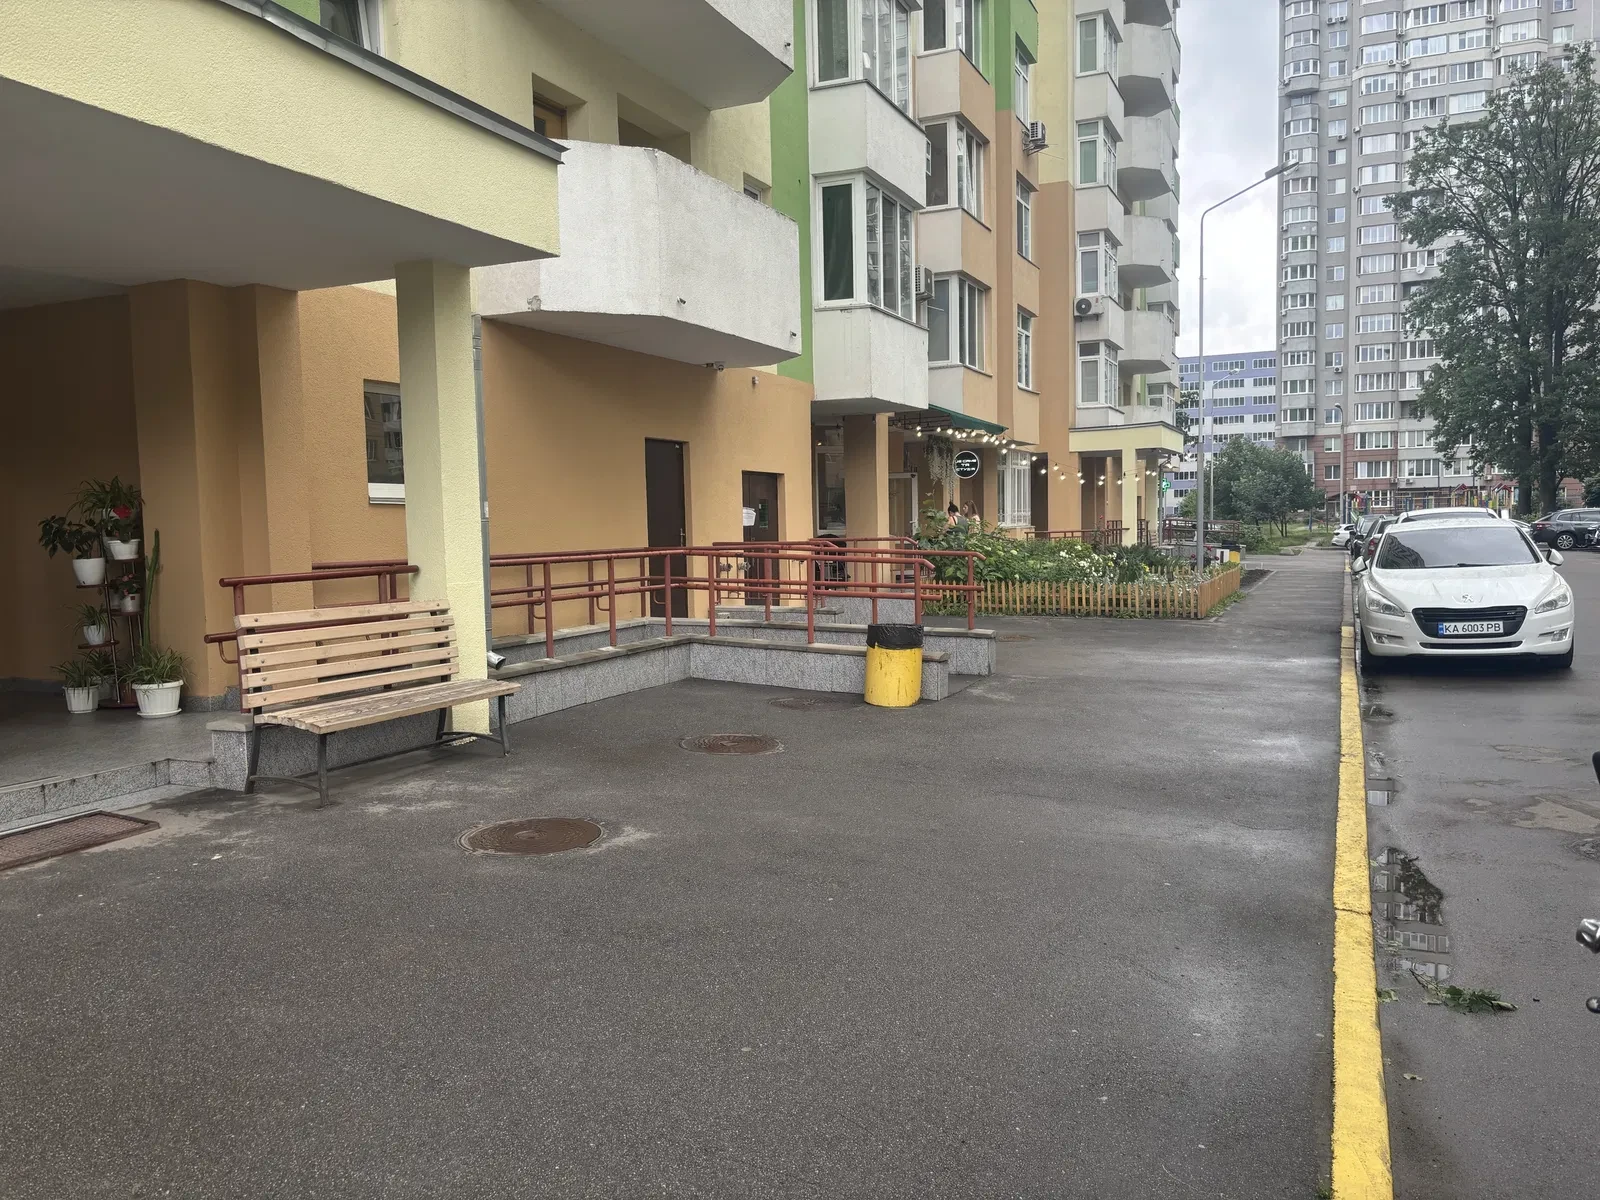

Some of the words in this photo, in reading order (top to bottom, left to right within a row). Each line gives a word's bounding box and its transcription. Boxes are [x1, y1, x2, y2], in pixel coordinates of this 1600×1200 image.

[1444, 624, 1460, 633] KA
[1462, 623, 1485, 633] 6003
[1486, 622, 1501, 632] PB
